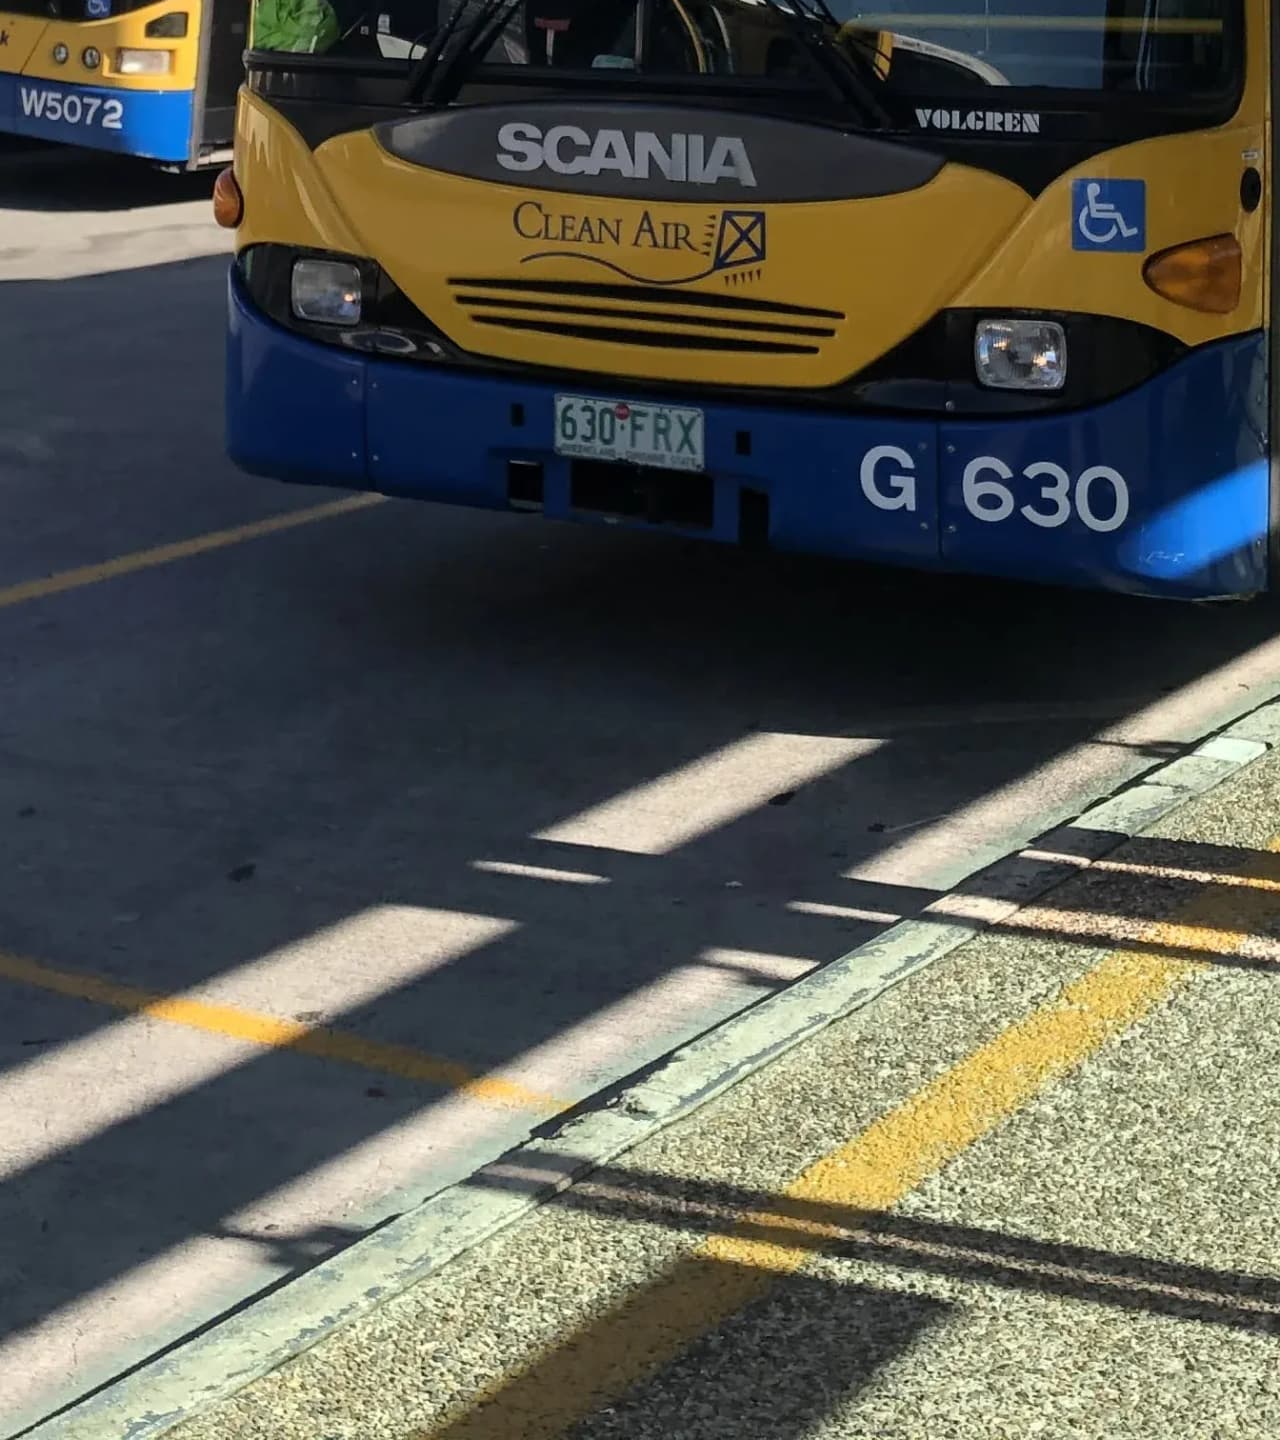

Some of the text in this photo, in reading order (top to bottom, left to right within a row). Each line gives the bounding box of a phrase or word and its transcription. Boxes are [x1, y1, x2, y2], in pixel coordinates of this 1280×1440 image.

[21, 87, 124, 129] W5072
[915, 108, 1040, 133] VOLGREN
[496, 122, 757, 187] SCANIA
[560, 404, 697, 455] 630 FRX
[860, 445, 1129, 532] G 630
